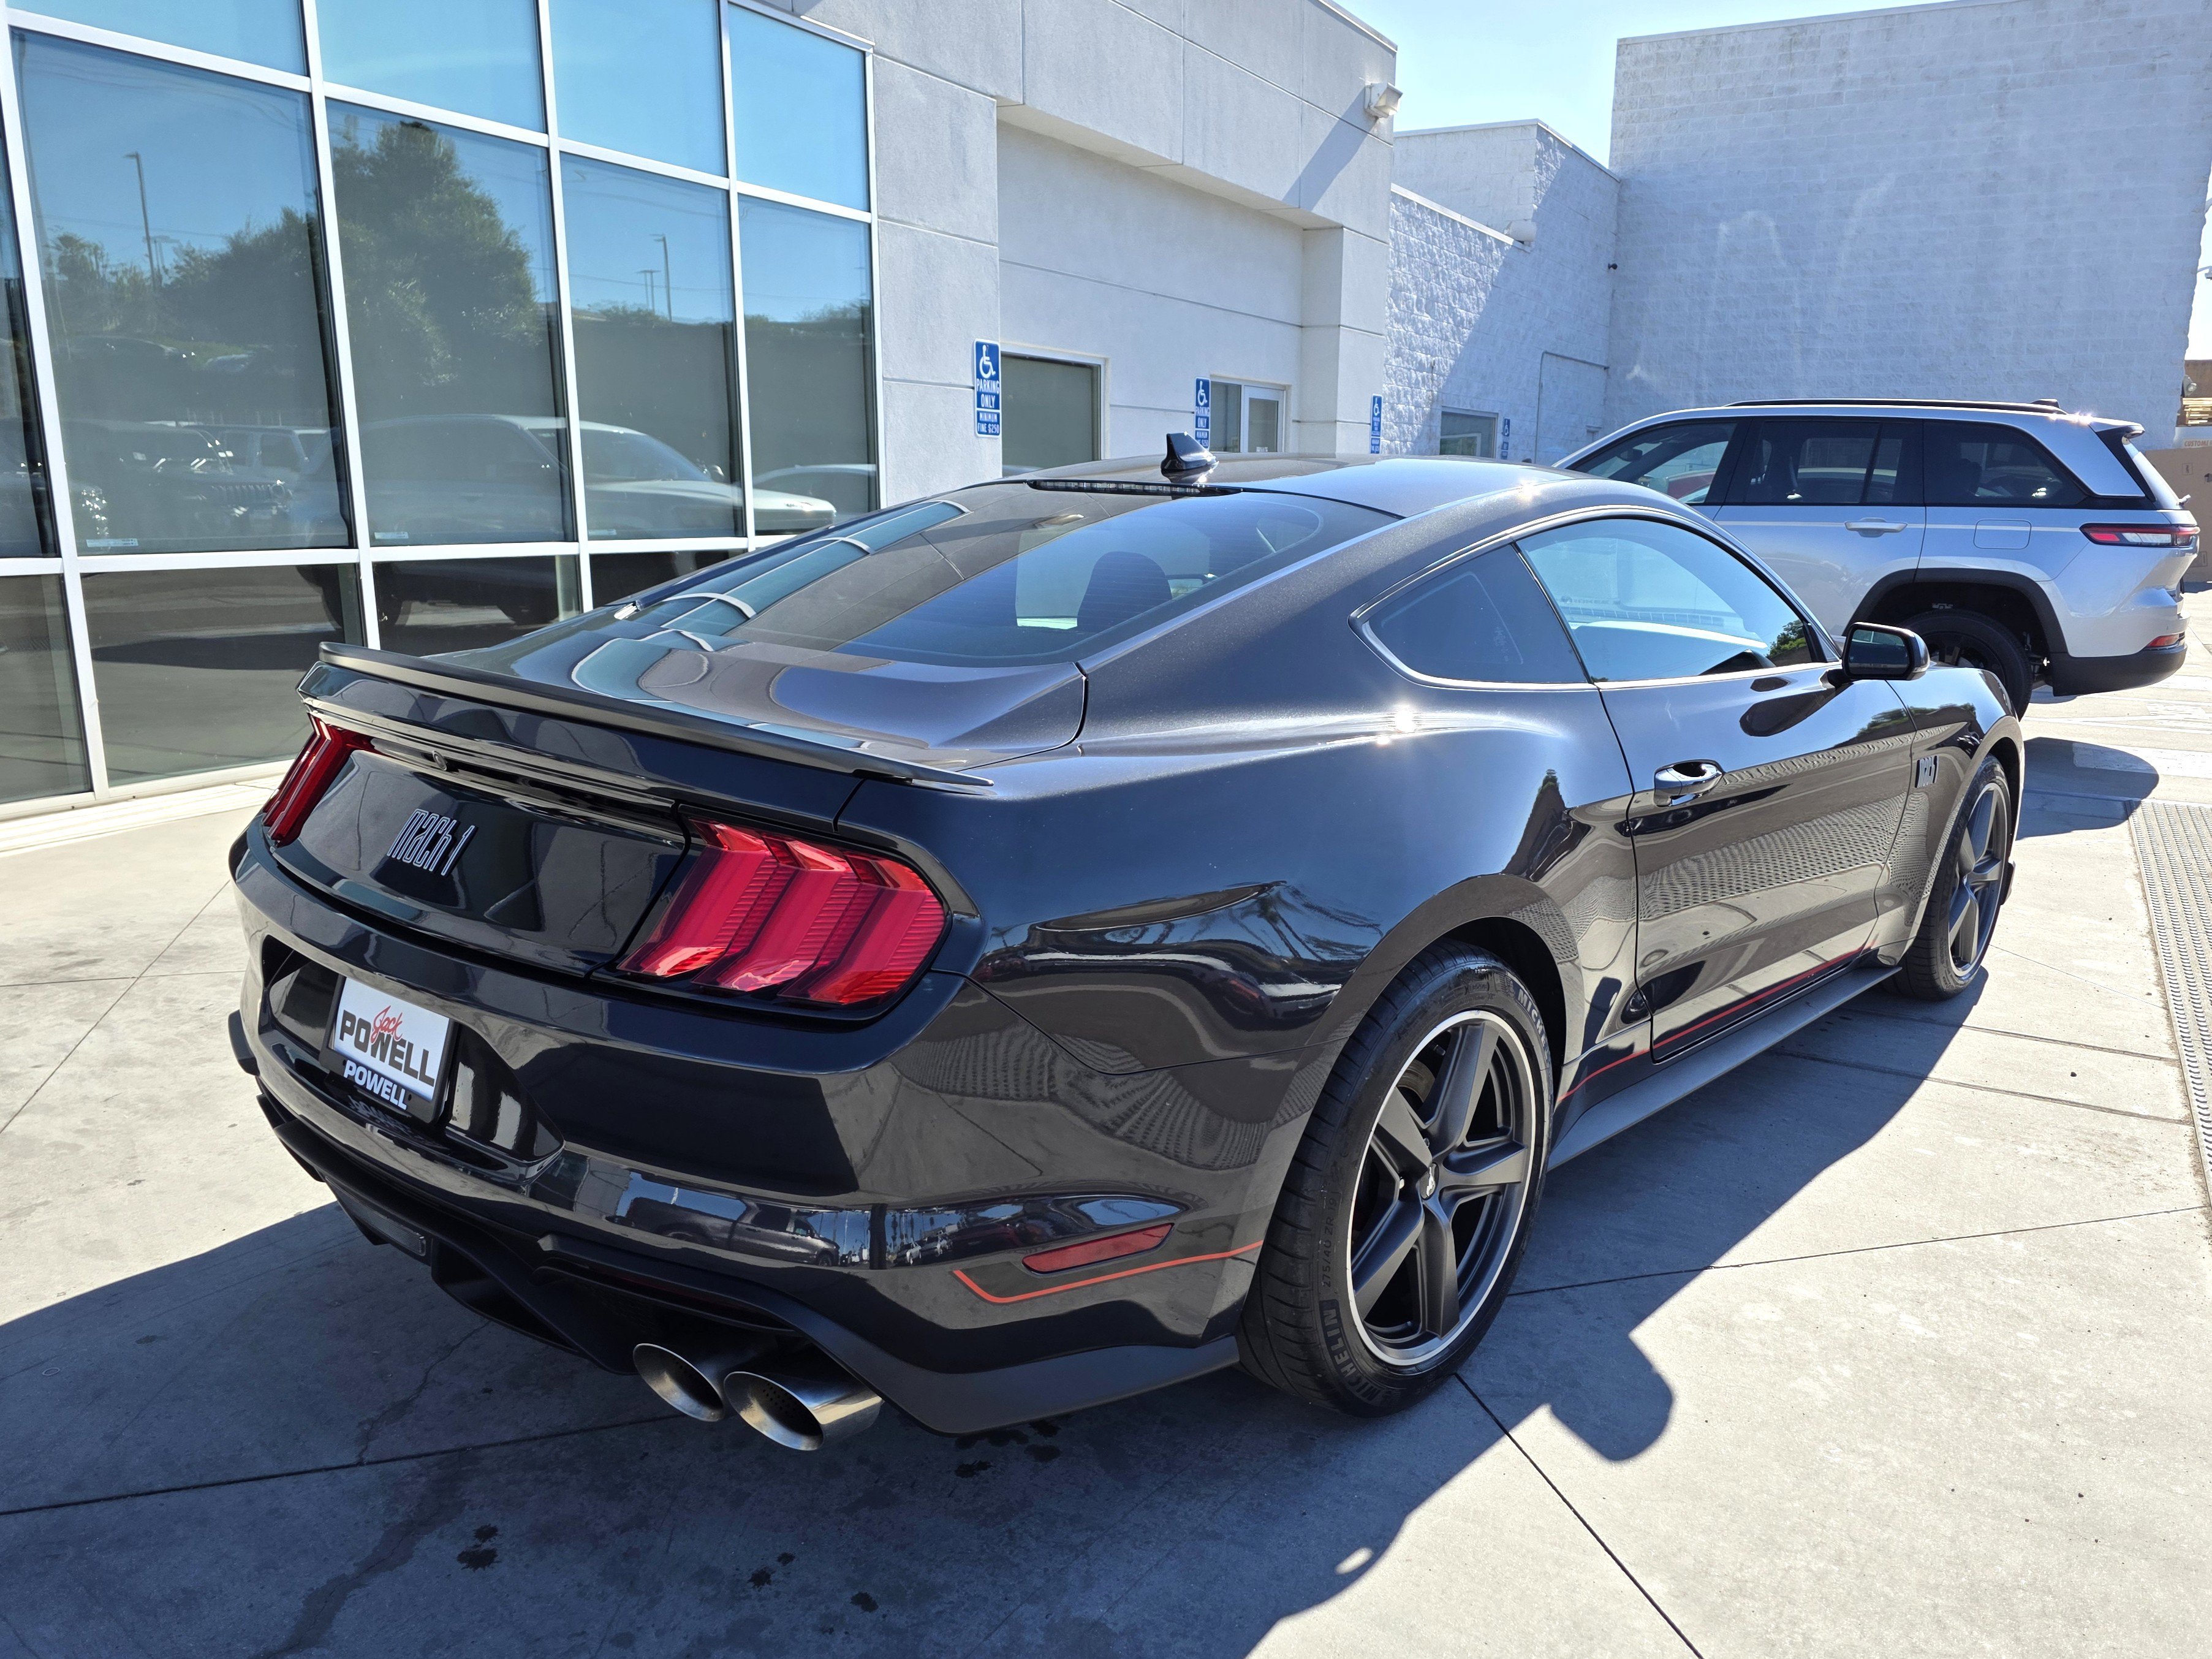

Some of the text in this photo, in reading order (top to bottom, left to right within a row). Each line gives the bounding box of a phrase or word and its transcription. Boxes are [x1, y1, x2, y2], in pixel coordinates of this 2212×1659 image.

[977, 379, 999, 393] PARKING
[981, 394, 996, 408] ONLY
[977, 422, 999, 434] FINE $250
[370, 1005, 403, 1043] Jack
[339, 1009, 435, 1087] POWELL
[343, 1060, 407, 1110] POWELL
